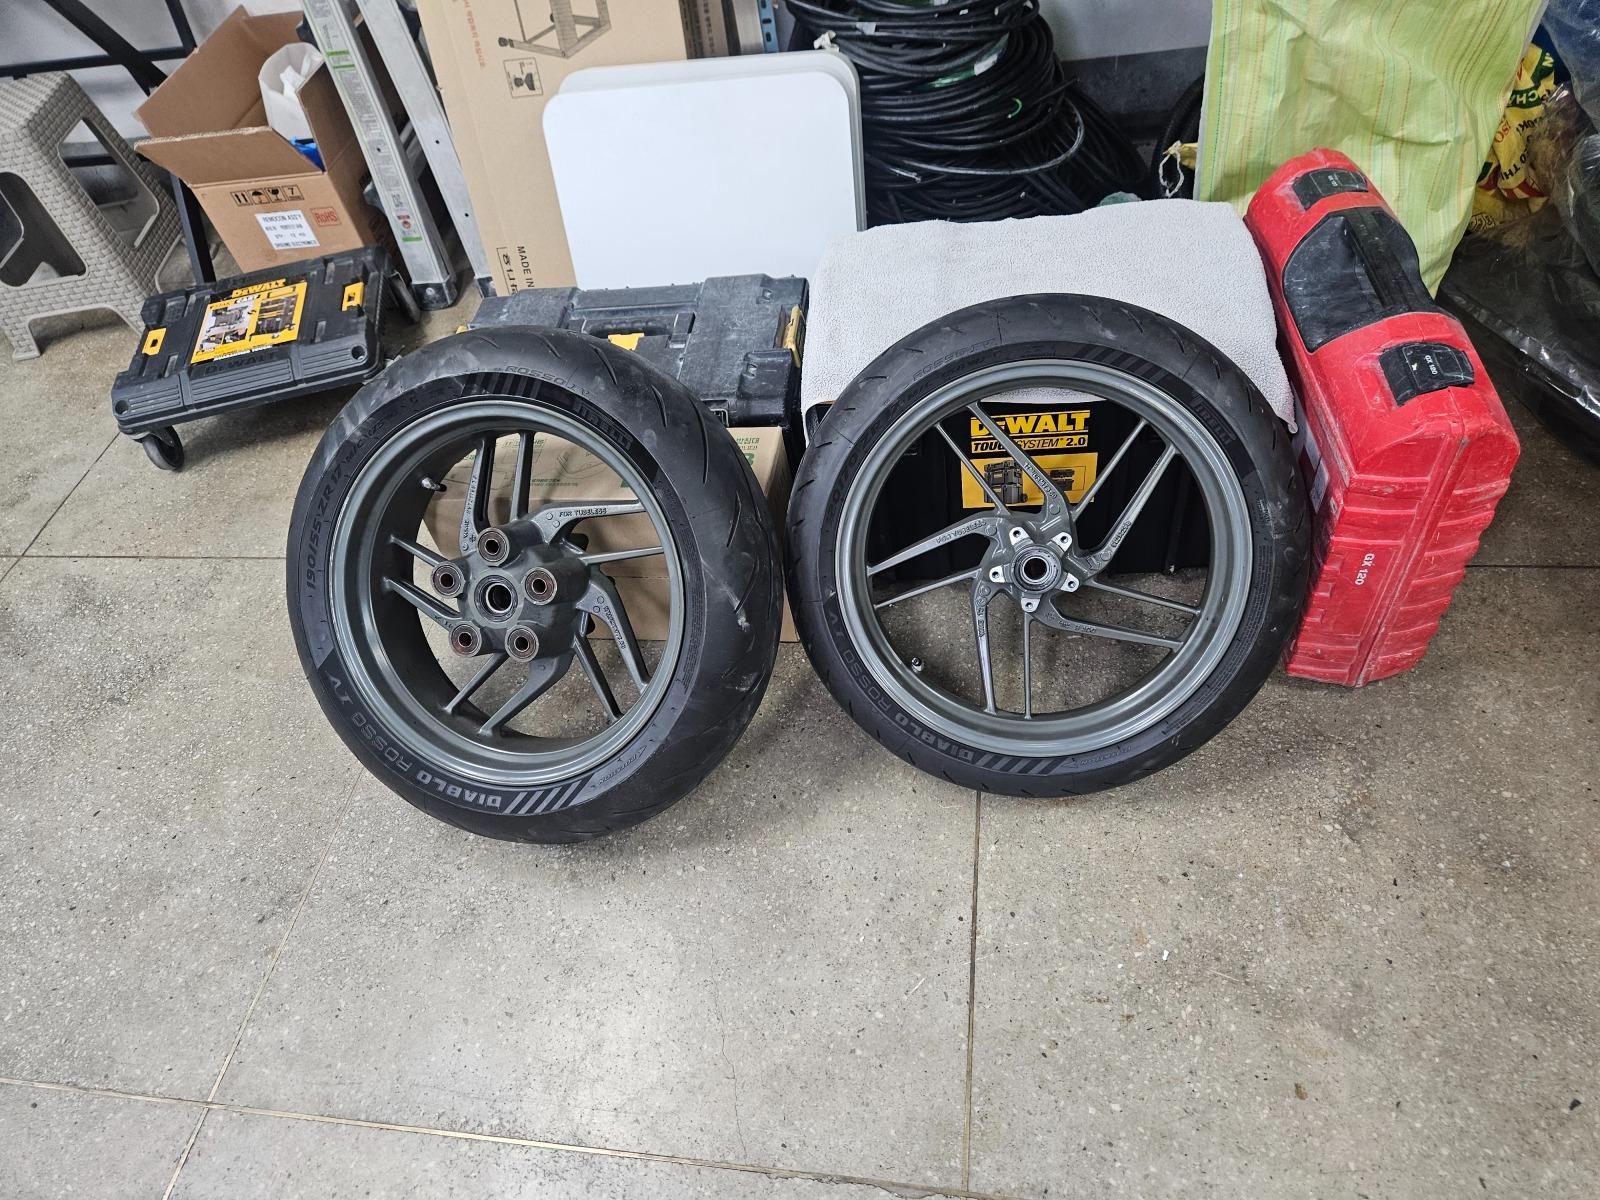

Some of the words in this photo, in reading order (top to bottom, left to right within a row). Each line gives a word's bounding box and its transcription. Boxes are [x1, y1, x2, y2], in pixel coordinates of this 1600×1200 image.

[314, 210, 338, 223] RoHS
[517, 246, 532, 275] MADE
[525, 277, 535, 288] IN
[503, 364, 565, 385] ROSSO
[1066, 437, 1085, 447] 2.0
[560, 510, 572, 518] FOR
[304, 518, 322, 592] 190/55
[1361, 553, 1376, 567] GX
[1354, 569, 1369, 586] 120
[840, 649, 892, 711] ROSSO
[349, 710, 413, 772] ROSSO
[894, 710, 975, 763] DIABLO
[415, 768, 502, 810] DIABLO
